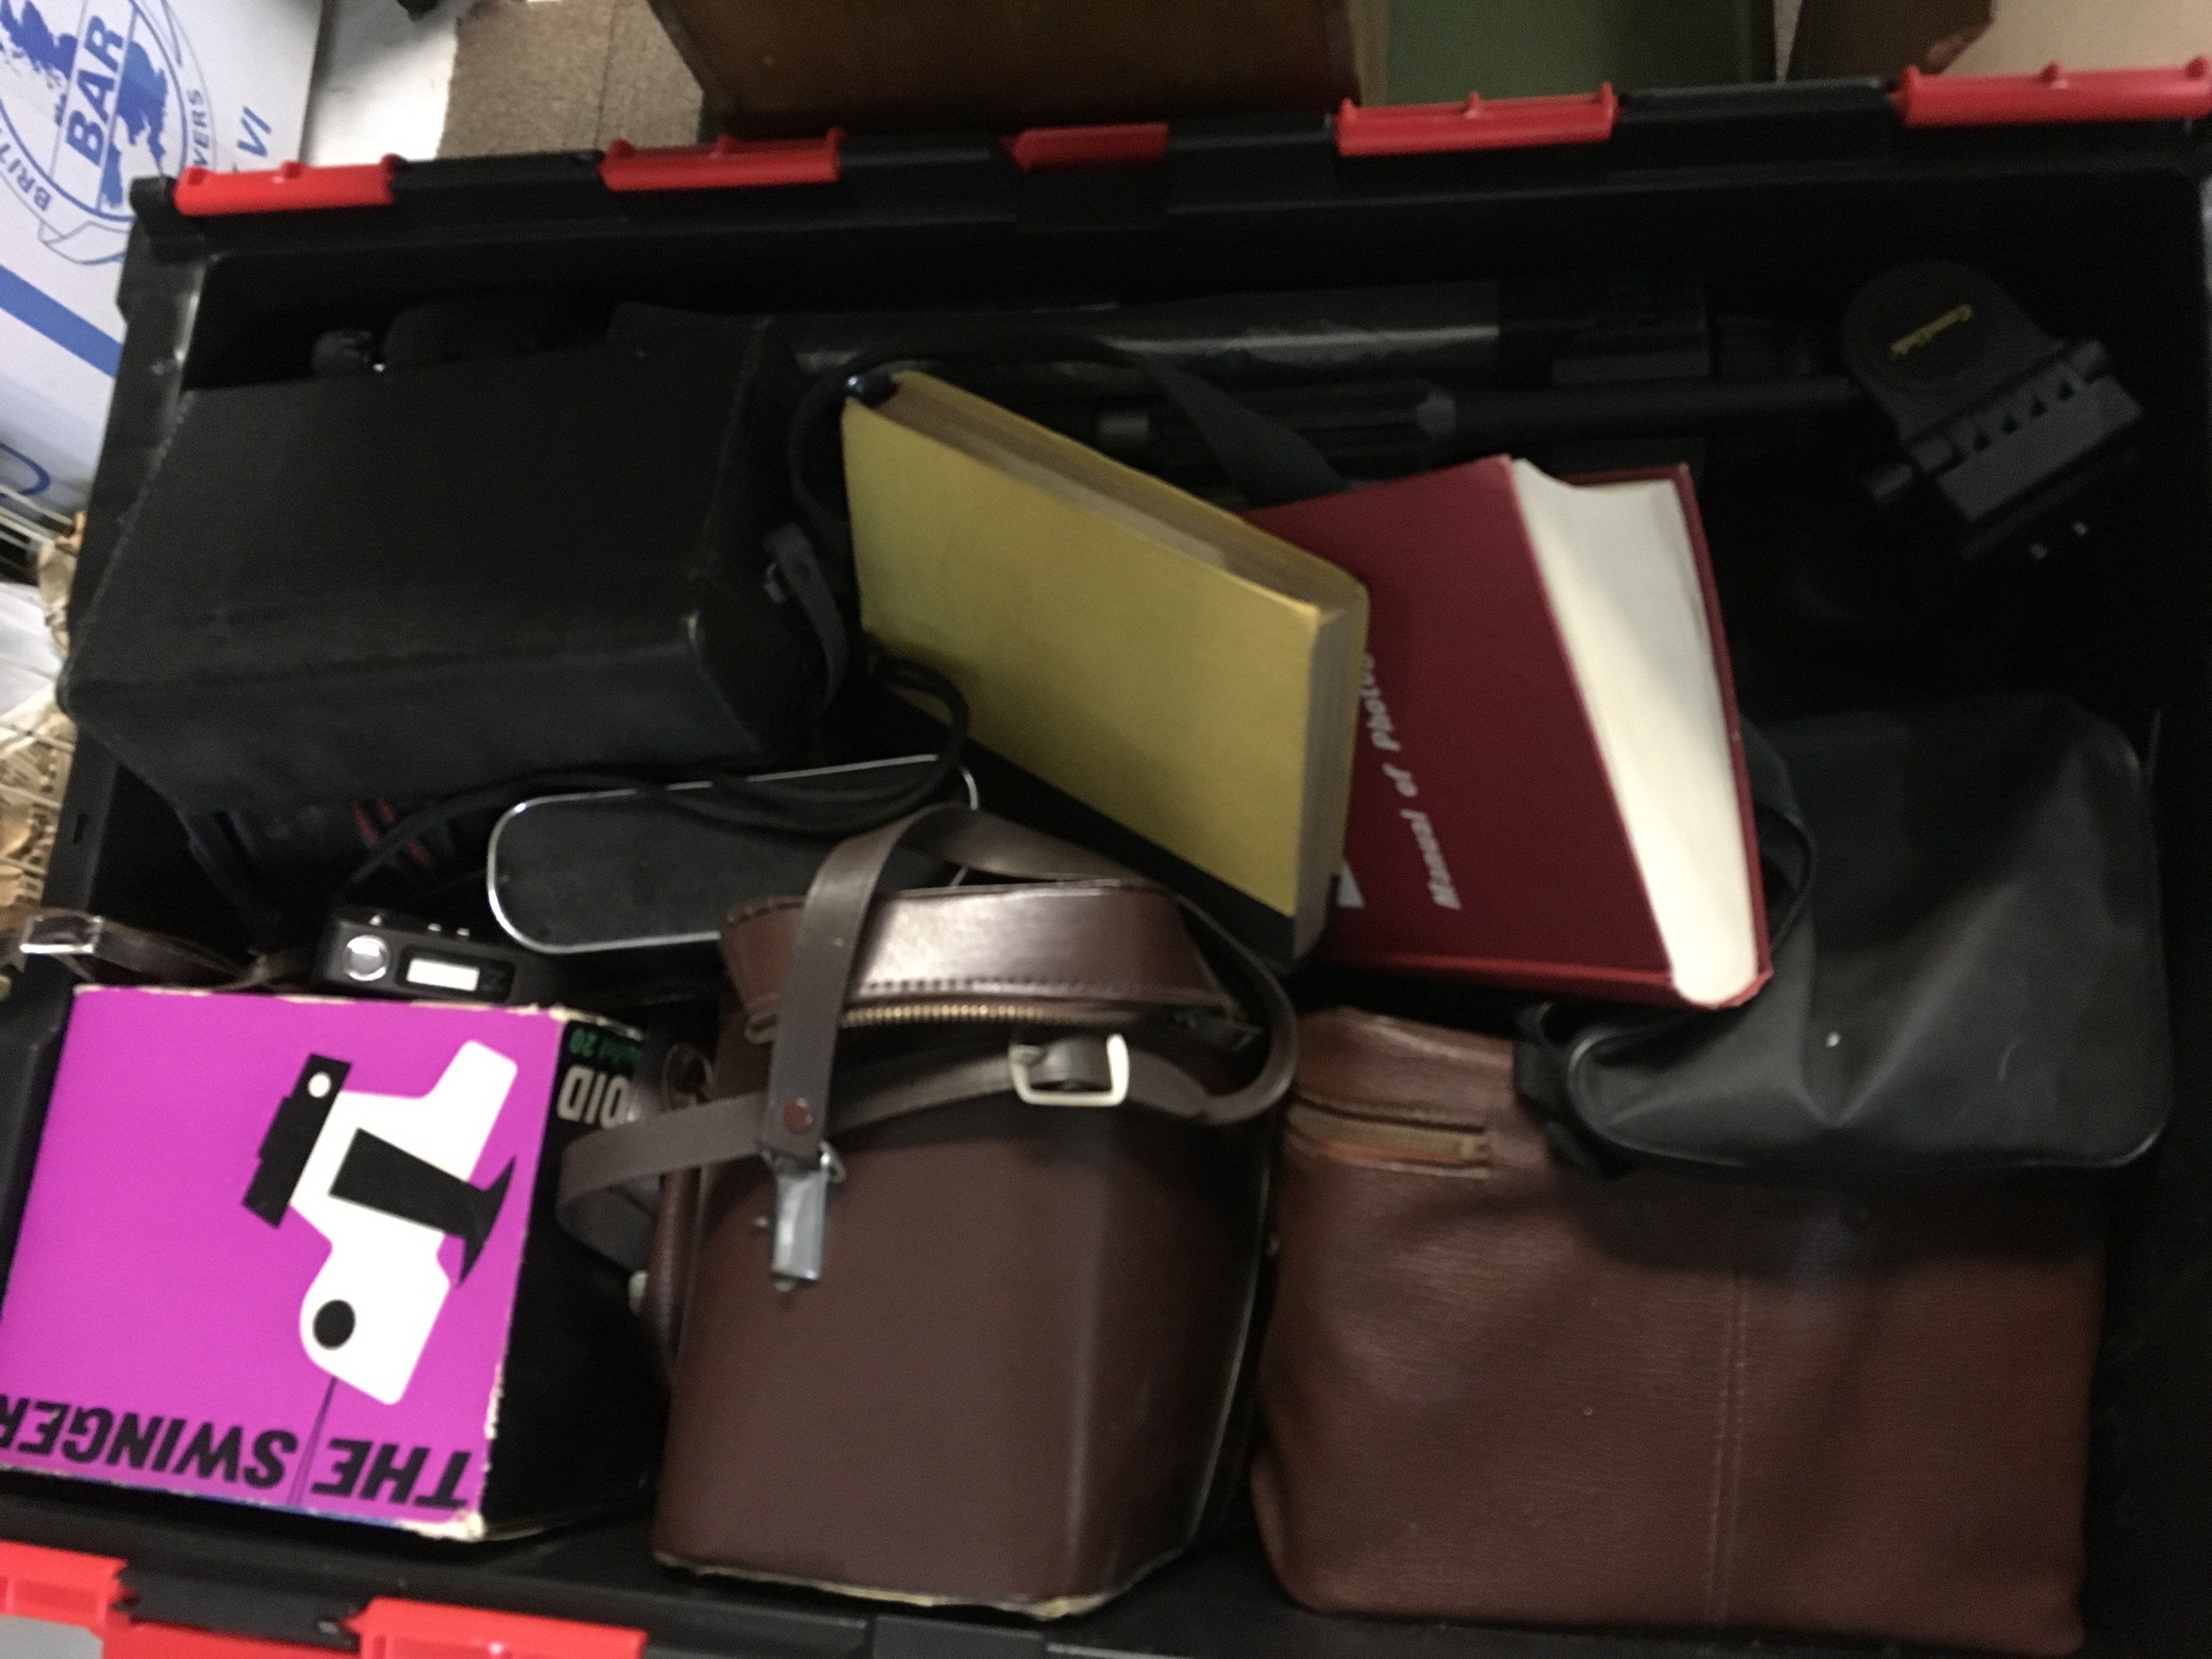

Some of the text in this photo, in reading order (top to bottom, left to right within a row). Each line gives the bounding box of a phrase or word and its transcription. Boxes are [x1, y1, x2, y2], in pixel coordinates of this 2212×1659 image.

[65, 14, 124, 167] BAR
[1381, 762, 1418, 797] of
[0, 1393, 472, 1511] THE SWINGER
